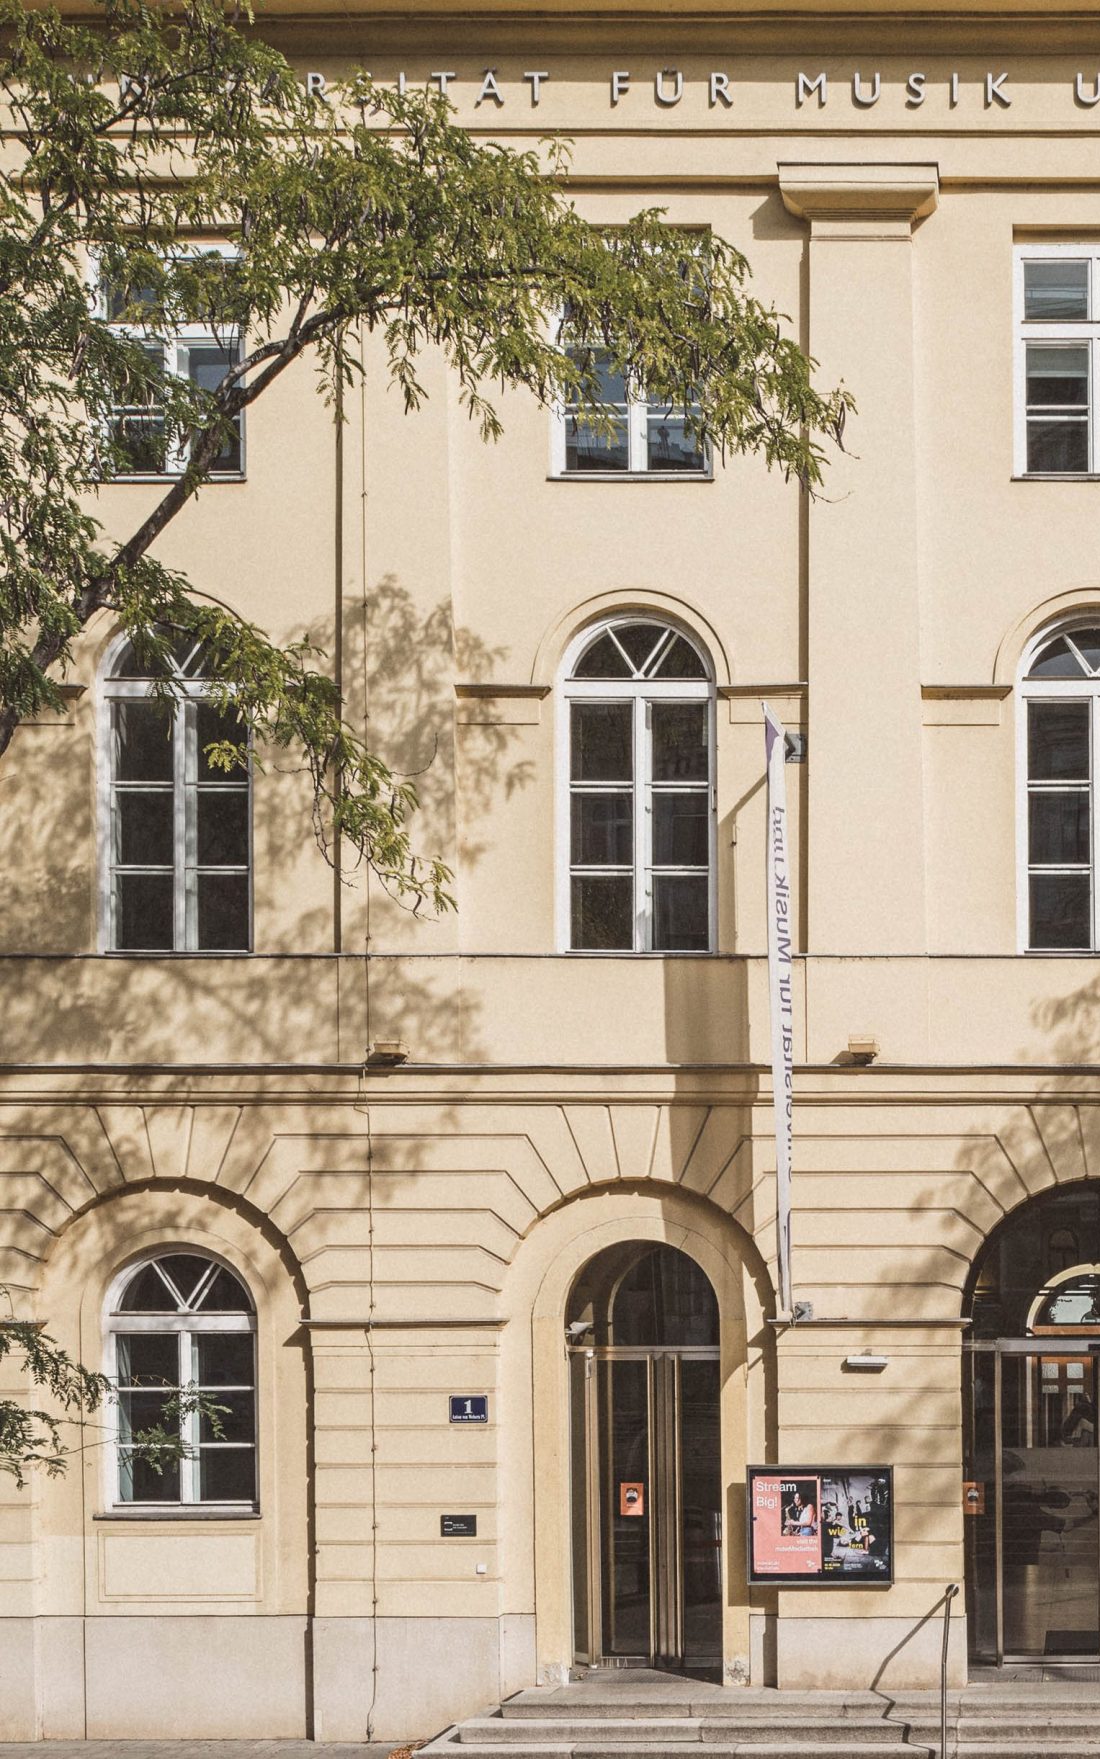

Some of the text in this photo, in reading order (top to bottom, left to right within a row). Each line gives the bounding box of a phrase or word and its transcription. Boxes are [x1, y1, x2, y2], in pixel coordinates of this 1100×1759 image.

[611, 67, 735, 104] FÜR
[797, 72, 1011, 105] MUSIK
[463, 1400, 473, 1414] 1
[756, 1482, 797, 1492] Stream
[756, 1497, 778, 1509] Big!
[854, 1515, 867, 1527] in
